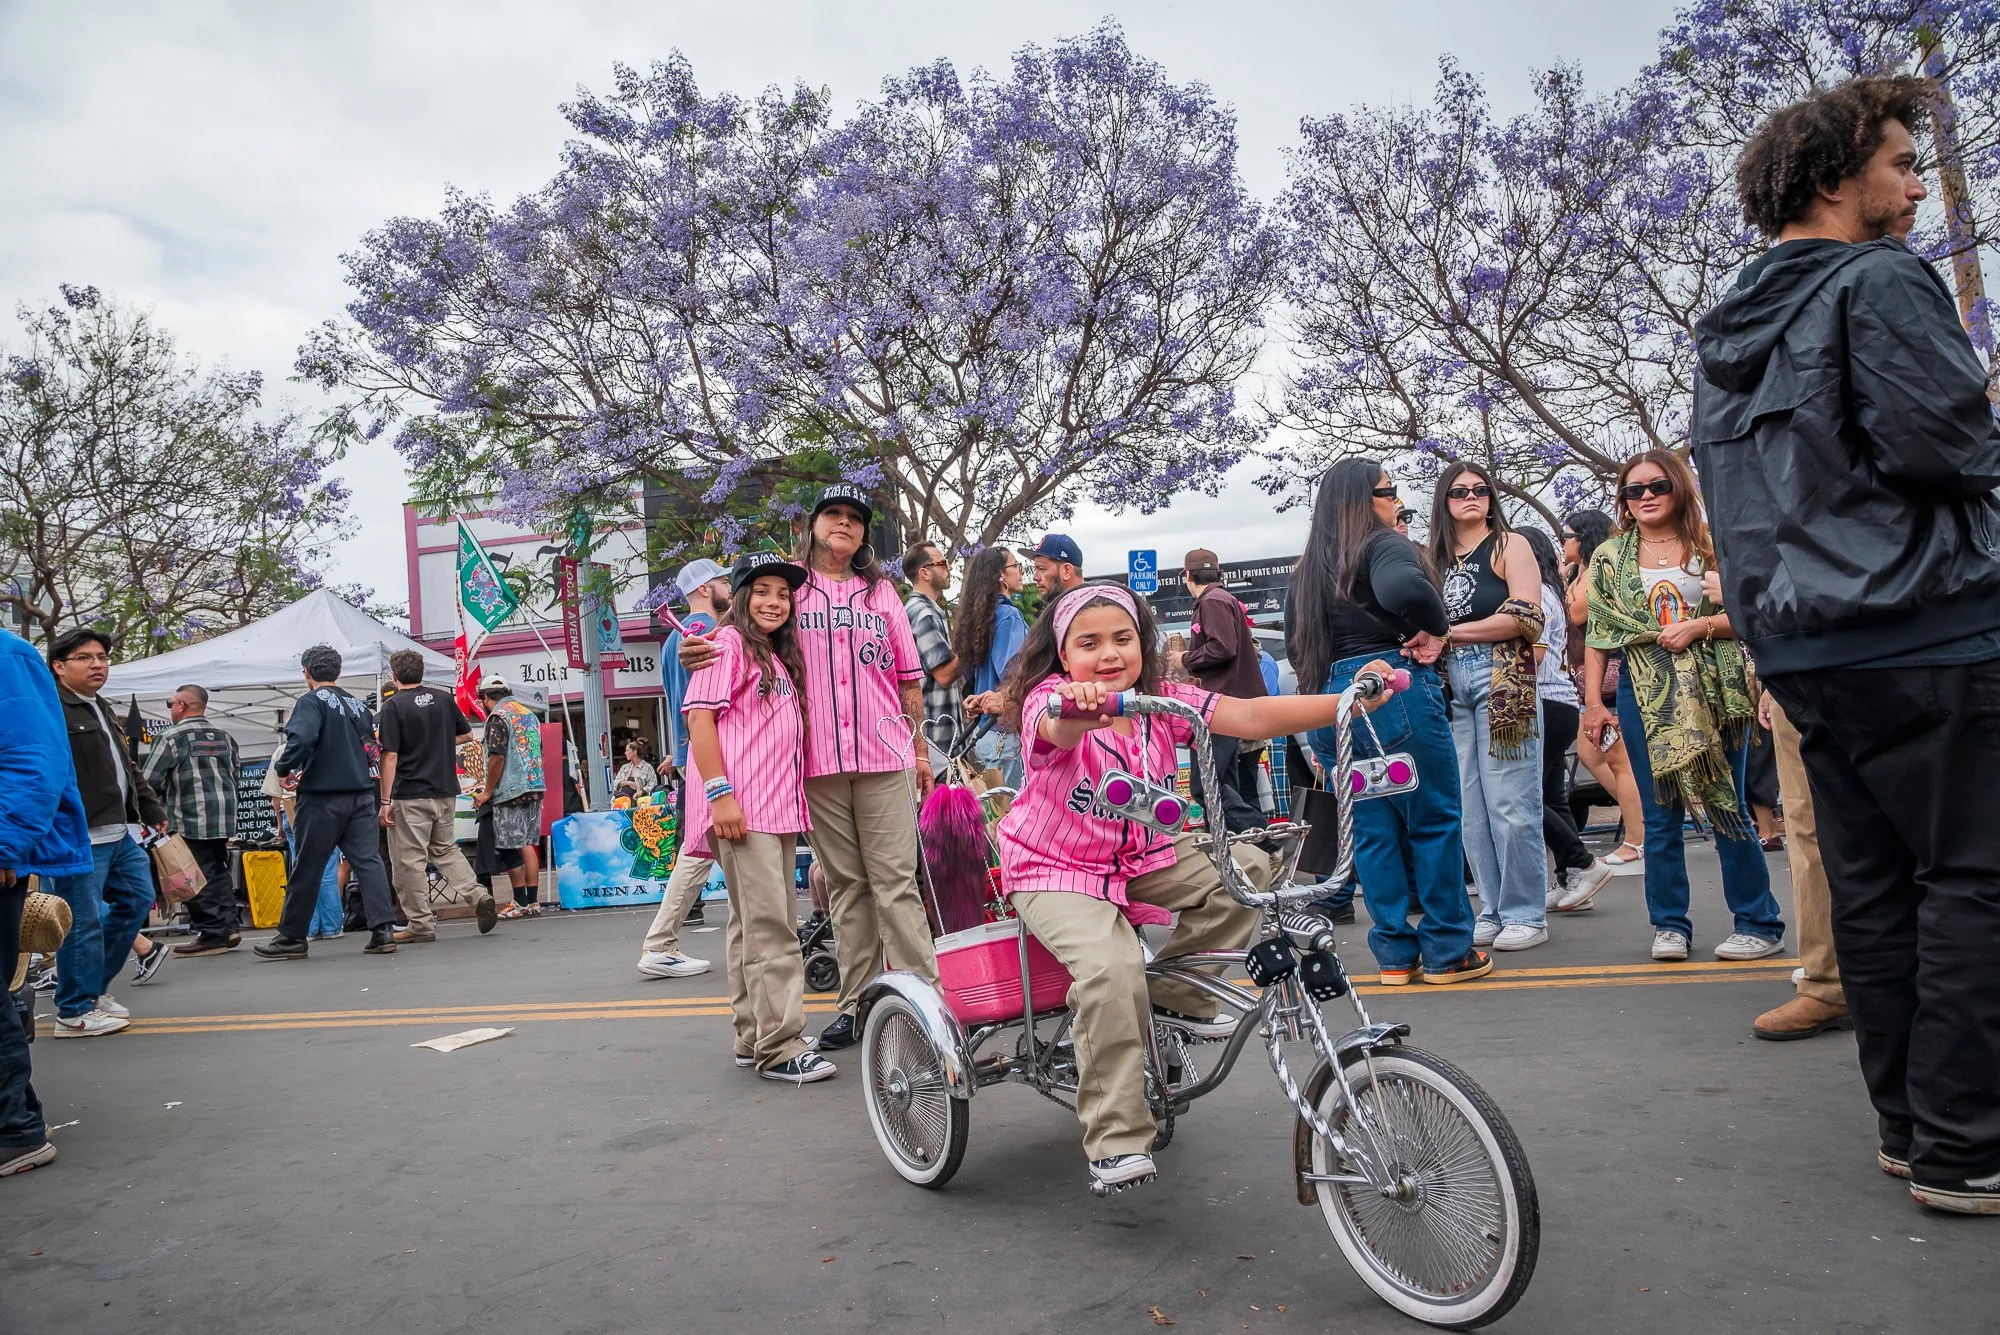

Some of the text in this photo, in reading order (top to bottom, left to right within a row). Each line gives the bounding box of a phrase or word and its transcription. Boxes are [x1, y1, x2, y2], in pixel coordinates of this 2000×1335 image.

[1130, 571, 1156, 580] PARKING
[1157, 577, 1176, 587] ATER!
[1242, 567, 1271, 578] PRIVATE
[1272, 564, 1298, 575] PARTIE
[1135, 581, 1151, 590] ONLY
[565, 564, 580, 662] LOGA AVENUE
[799, 611, 826, 630] an
[858, 641, 894, 671] 619
[520, 662, 568, 683] Loka
[242, 768, 268, 778] HAIRC
[250, 779, 265, 788] FAD
[238, 801, 254, 809] ARD
[237, 811, 255, 820] ZOR
[237, 820, 272, 830] LINE UPS
[236, 832, 247, 840] OT
